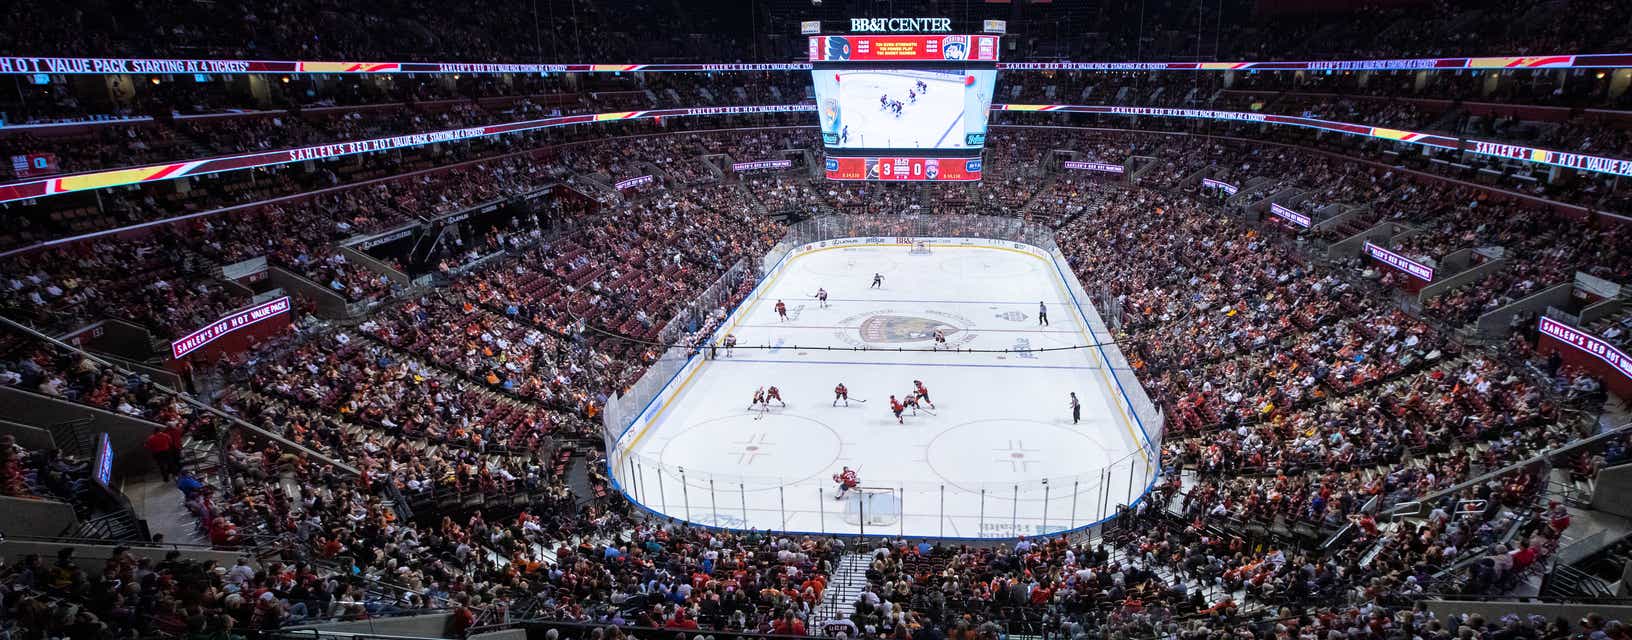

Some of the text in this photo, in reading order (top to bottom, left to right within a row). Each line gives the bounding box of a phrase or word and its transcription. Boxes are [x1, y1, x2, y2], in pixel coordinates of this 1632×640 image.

[850, 18, 953, 32] BB&T CENTER
[0, 59, 40, 72] HOT
[46, 59, 92, 72] VALUE
[93, 59, 128, 72] PACK
[132, 60, 184, 72] STARTING
[187, 60, 198, 72] AT
[201, 60, 208, 72] 4
[1006, 62, 1041, 70] SAHLEN'S
[687, 106, 722, 115] SAHLEN'S
[1111, 106, 1146, 114] SAHLEN'S
[1168, 108, 1182, 116] HOT
[290, 144, 345, 160] SAHLEN'S
[351, 141, 369, 152] RED
[374, 139, 391, 150] HOT
[393, 136, 413, 146] VALUE
[413, 134, 428, 144] PACK
[430, 131, 454, 143] STARTING
[1475, 142, 1526, 159] SAHLEN'S
[1559, 153, 1585, 168] HOT
[1586, 156, 1620, 174] VALUE
[883, 163, 891, 175] 3
[914, 163, 922, 175] 0
[177, 301, 287, 354] SAHLEN'S RED HOT VALUE PACK
[1543, 322, 1585, 346] SAHLEN'S
[1587, 340, 1606, 355] RED
[1606, 350, 1620, 363] HOT
